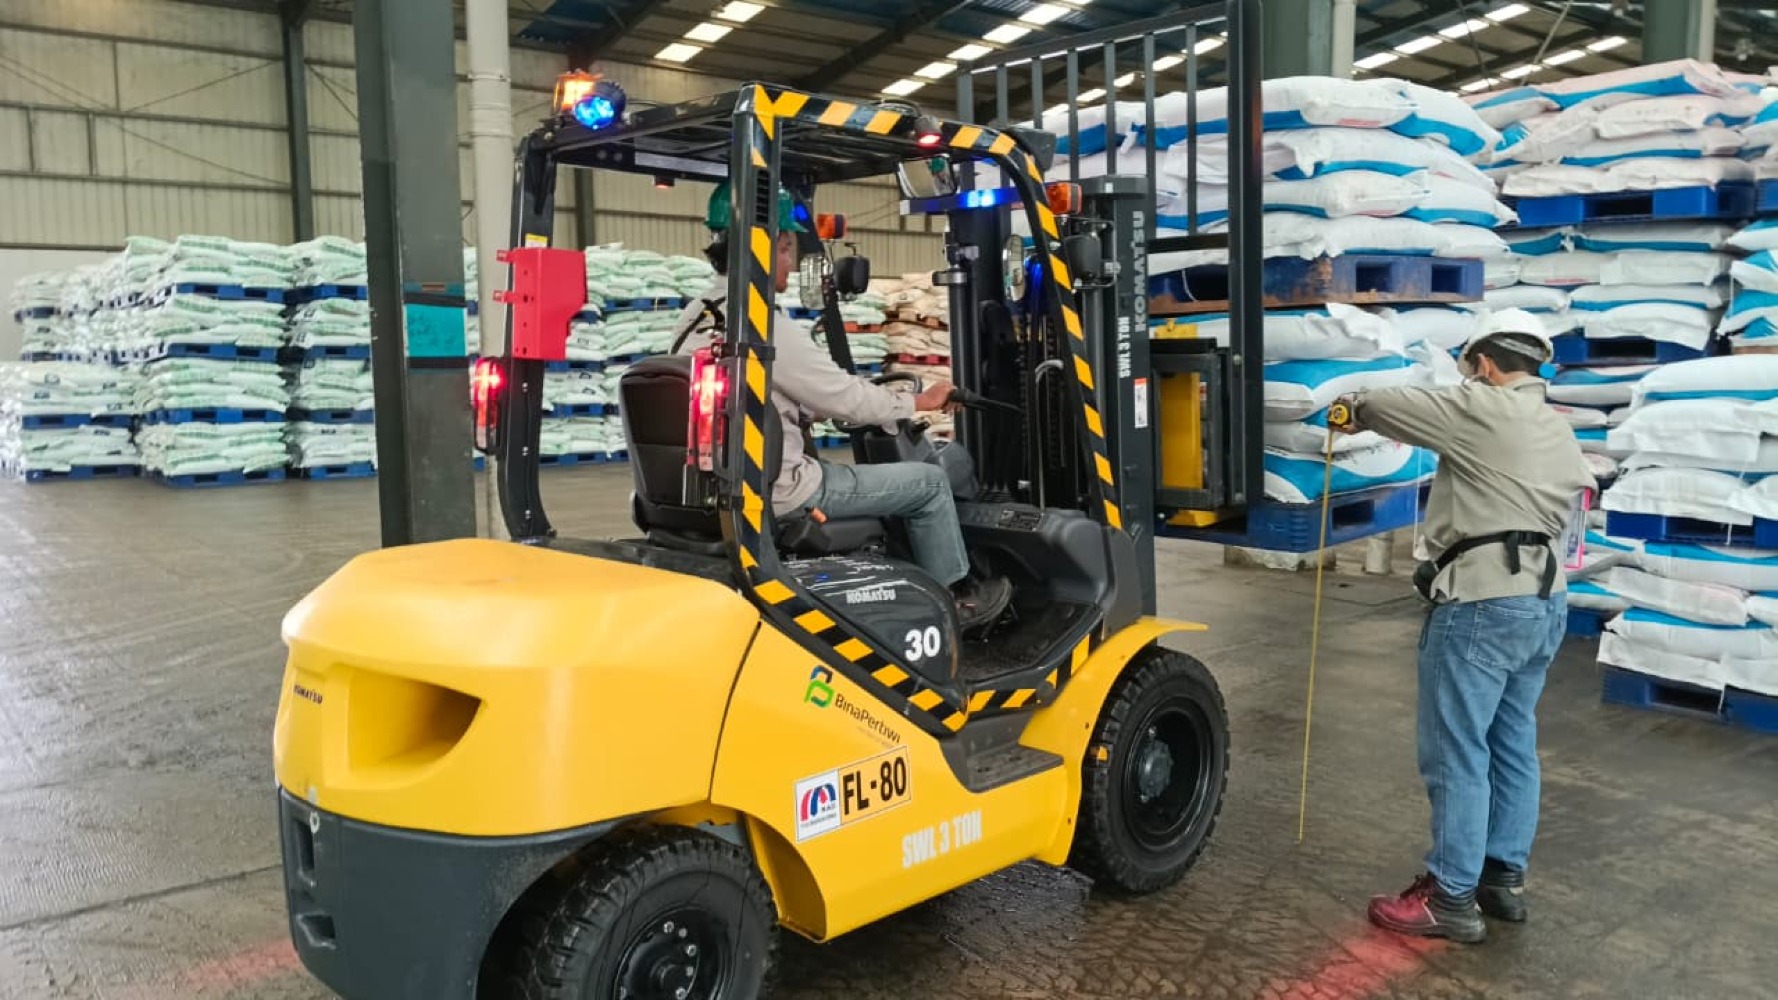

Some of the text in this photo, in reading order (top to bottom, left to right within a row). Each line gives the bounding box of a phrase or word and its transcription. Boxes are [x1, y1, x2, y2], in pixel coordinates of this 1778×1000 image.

[1132, 210, 1147, 332] KOMATSU
[1117, 352, 1132, 379] SWL
[1118, 342, 1131, 351] 3
[846, 587, 897, 604] KOMATSU
[905, 625, 941, 662] 30
[834, 693, 901, 744] BinaPertiwi
[842, 756, 907, 816] FL-80
[902, 810, 983, 869] SWL 3 TON
